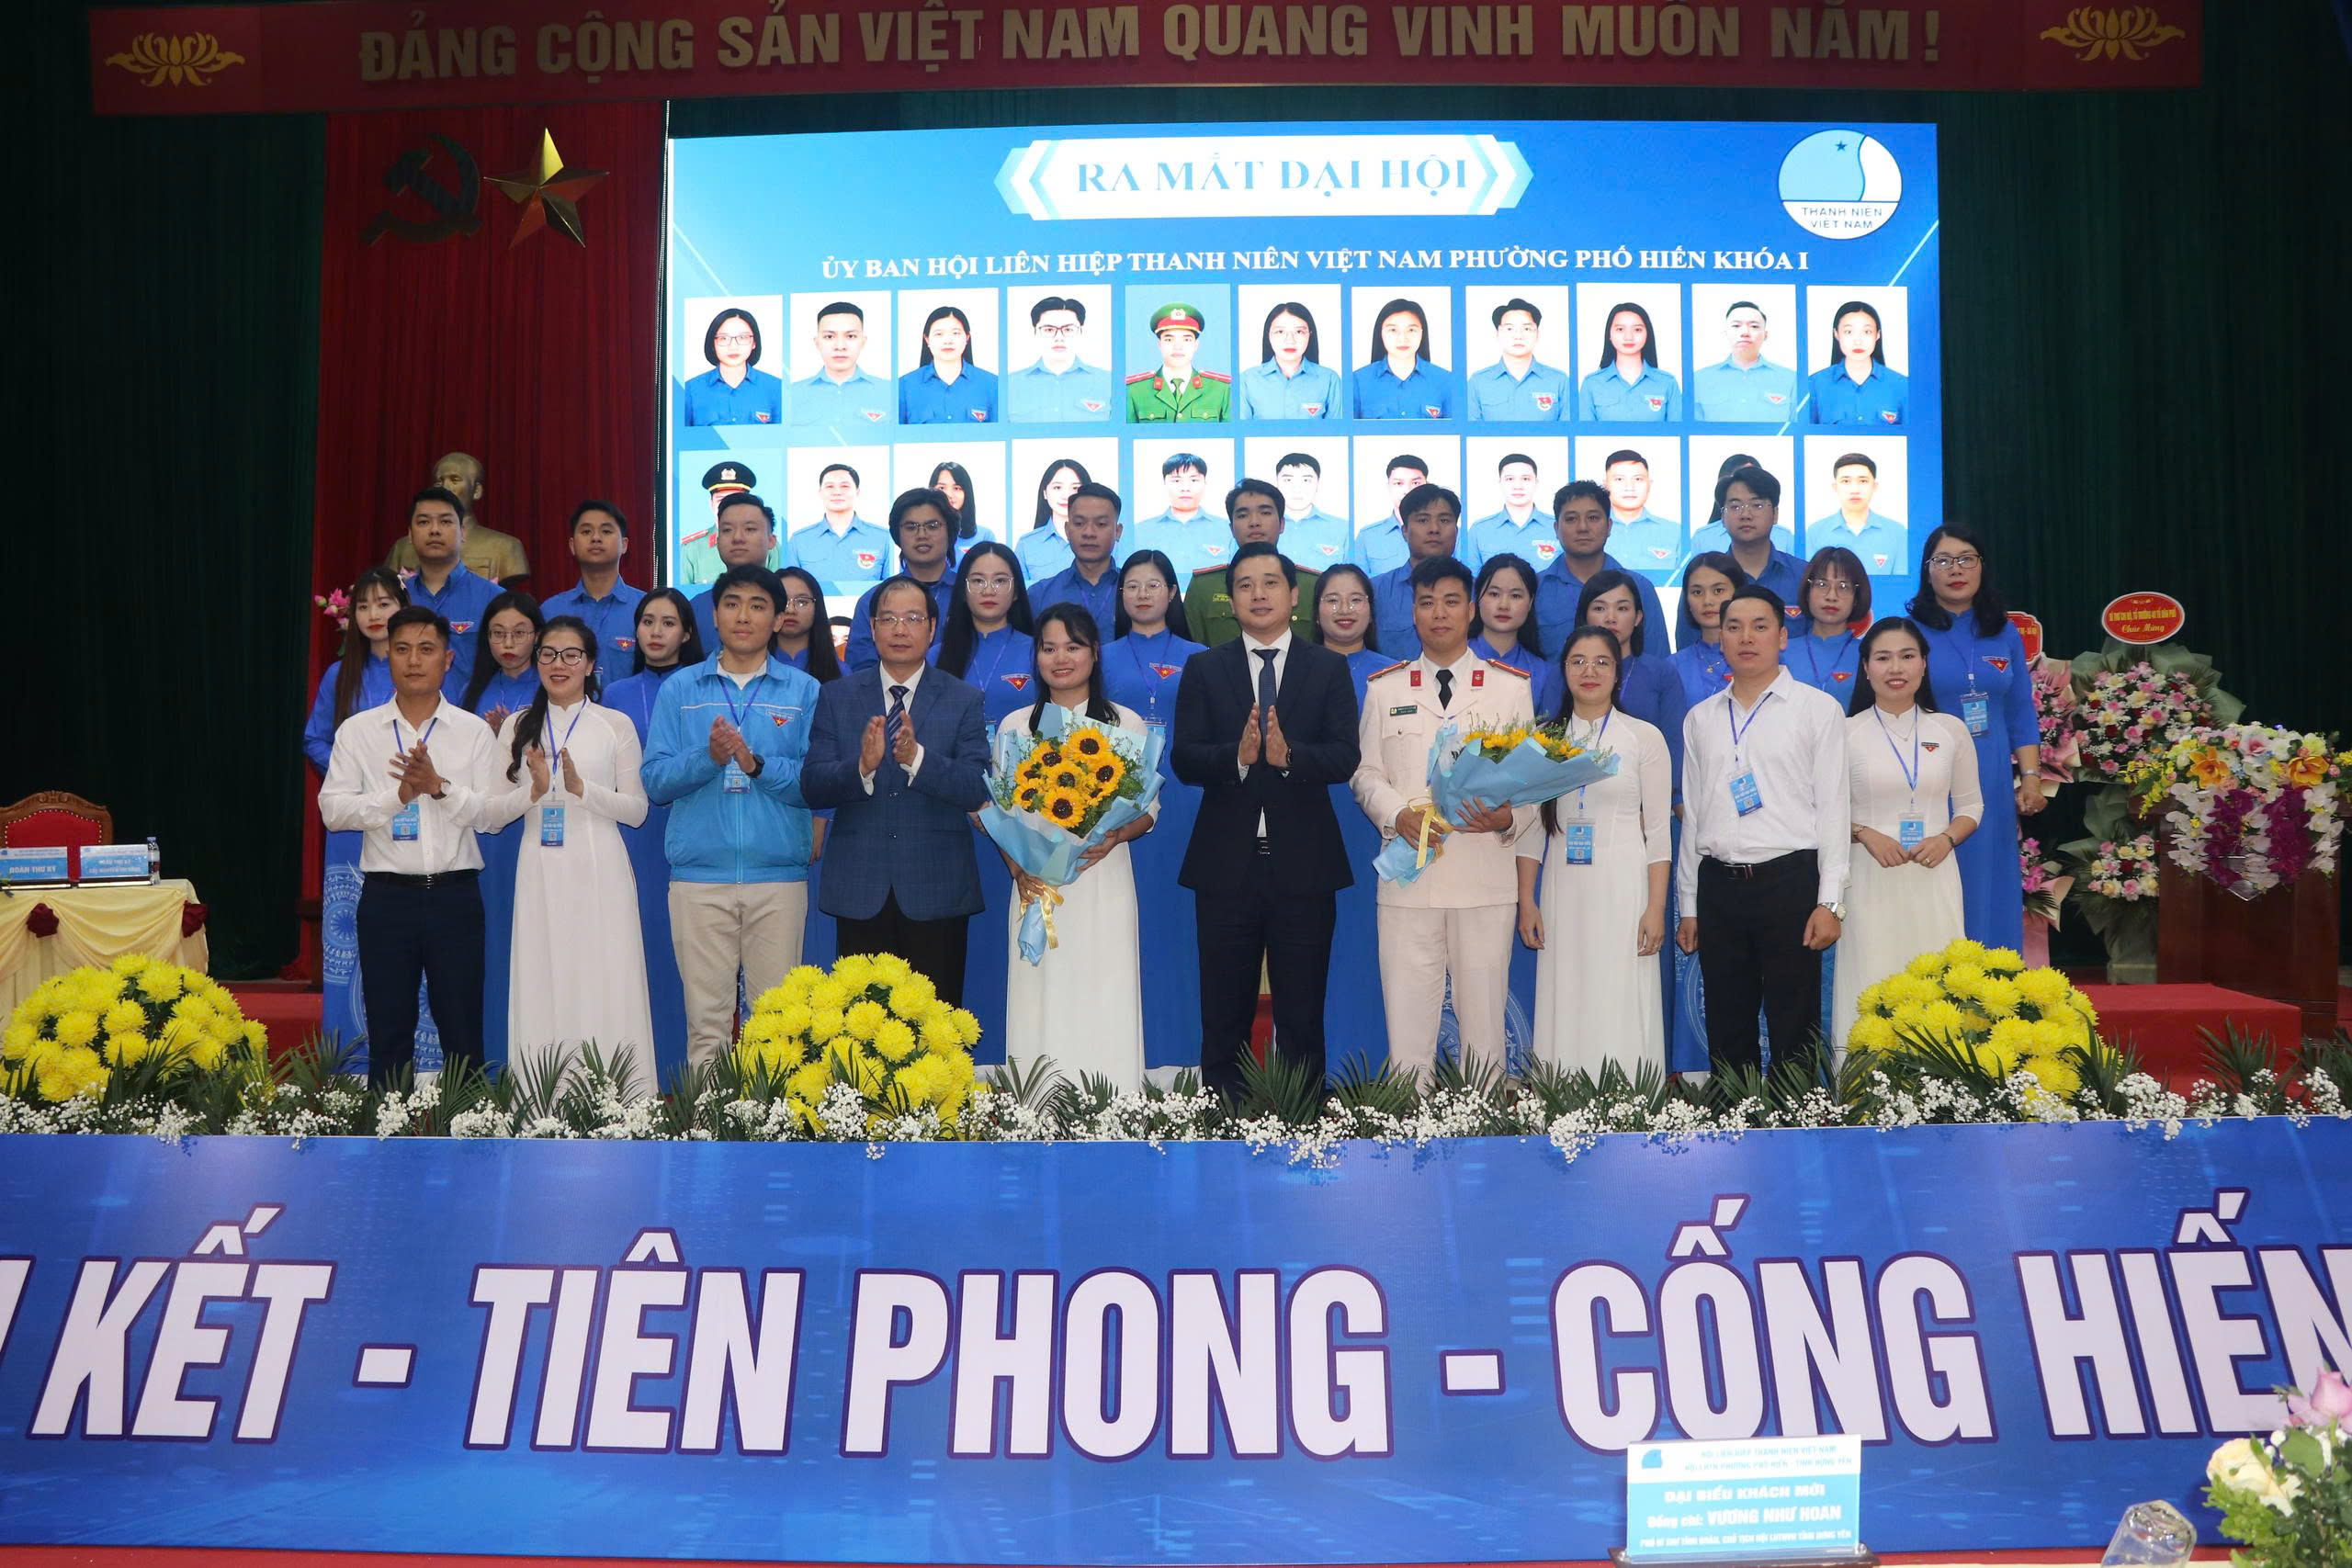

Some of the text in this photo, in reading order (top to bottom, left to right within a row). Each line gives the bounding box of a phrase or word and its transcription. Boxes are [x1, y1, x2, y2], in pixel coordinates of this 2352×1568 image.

[359, 11, 516, 82] ĐẢNG
[536, 14, 695, 84] CỘNG
[717, 0, 841, 67] SẢN
[858, 0, 984, 73] VIỆT
[1002, 6, 1140, 60] NAM
[1163, 5, 1369, 61] QUANG
[1392, 5, 1534, 57] VINH
[1770, 0, 1910, 61] NĂM
[1077, 162, 1141, 193] RA
[1381, 153, 1467, 197] HỘI
[1801, 207, 1847, 217] THANH
[1844, 220, 1873, 229] NAM
[821, 254, 859, 279] ỦY
[865, 258, 919, 277] BAN
[927, 253, 978, 280] HỘI
[984, 250, 1049, 275] LIÊN
[1057, 251, 1123, 276] HIỆP
[1127, 251, 1227, 272] THANH
[1232, 246, 1299, 270] NIÊN
[1306, 248, 1372, 273] VIỆT
[1378, 250, 1442, 269] NAM
[1449, 245, 1569, 269] PHƯỜNG
[1575, 245, 1633, 268] PHỐ
[1639, 245, 1706, 269] HIẾN
[1713, 246, 1793, 270] KHÓA
[27, 1202, 337, 1442] KẾT
[463, 1227, 807, 1455] TIÊN
[839, 1264, 1394, 1463] PHONG
[1550, 1193, 1999, 1451] CỐNG
